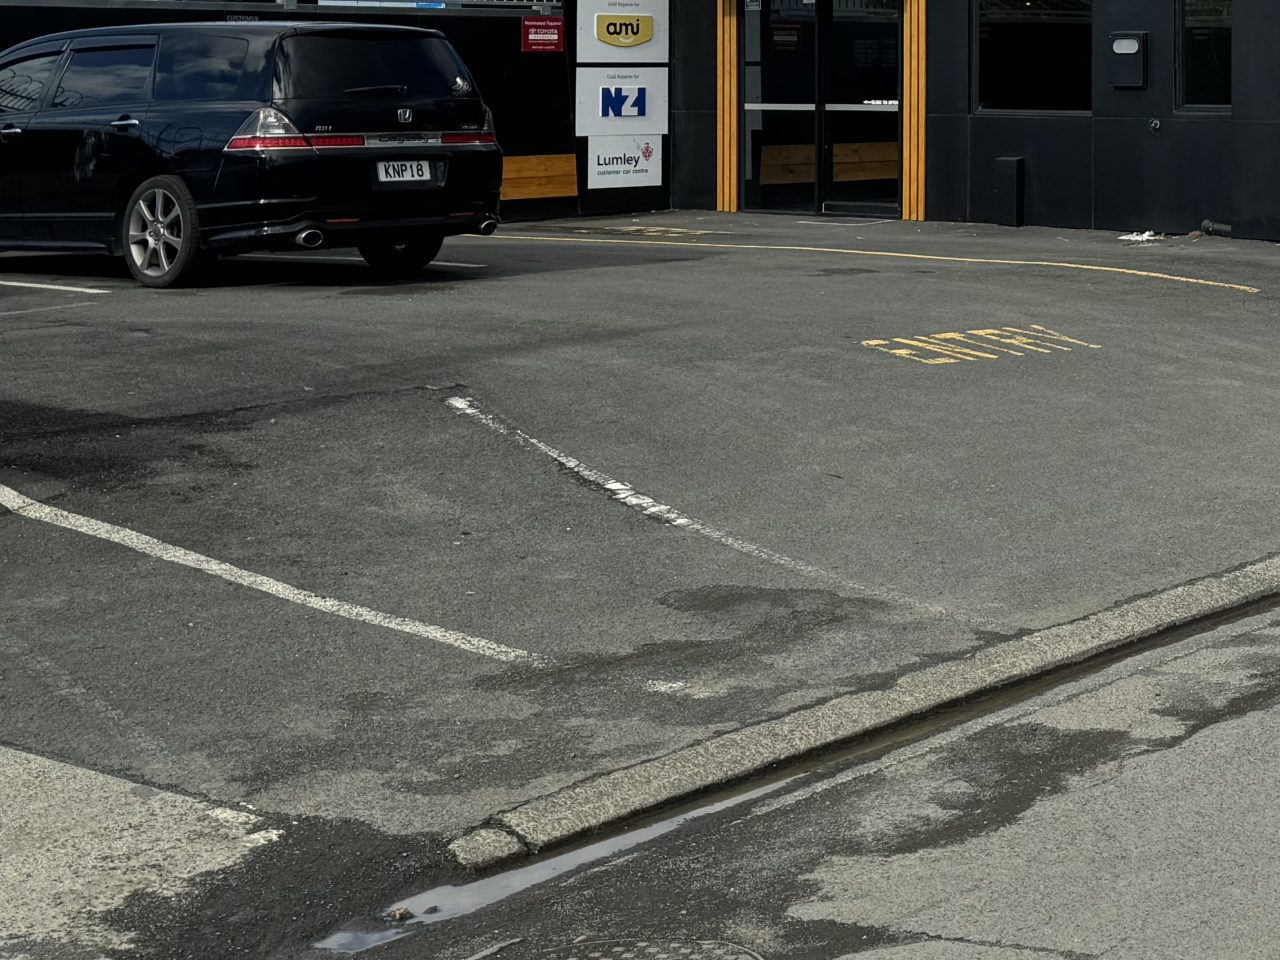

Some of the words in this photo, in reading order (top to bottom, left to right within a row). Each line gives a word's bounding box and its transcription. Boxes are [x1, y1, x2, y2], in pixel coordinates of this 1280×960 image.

[606, 19, 640, 36] ami
[601, 87, 646, 117] NZI
[597, 153, 640, 168] Lumley
[384, 162, 425, 180] KNP18
[597, 168, 621, 176] customer
